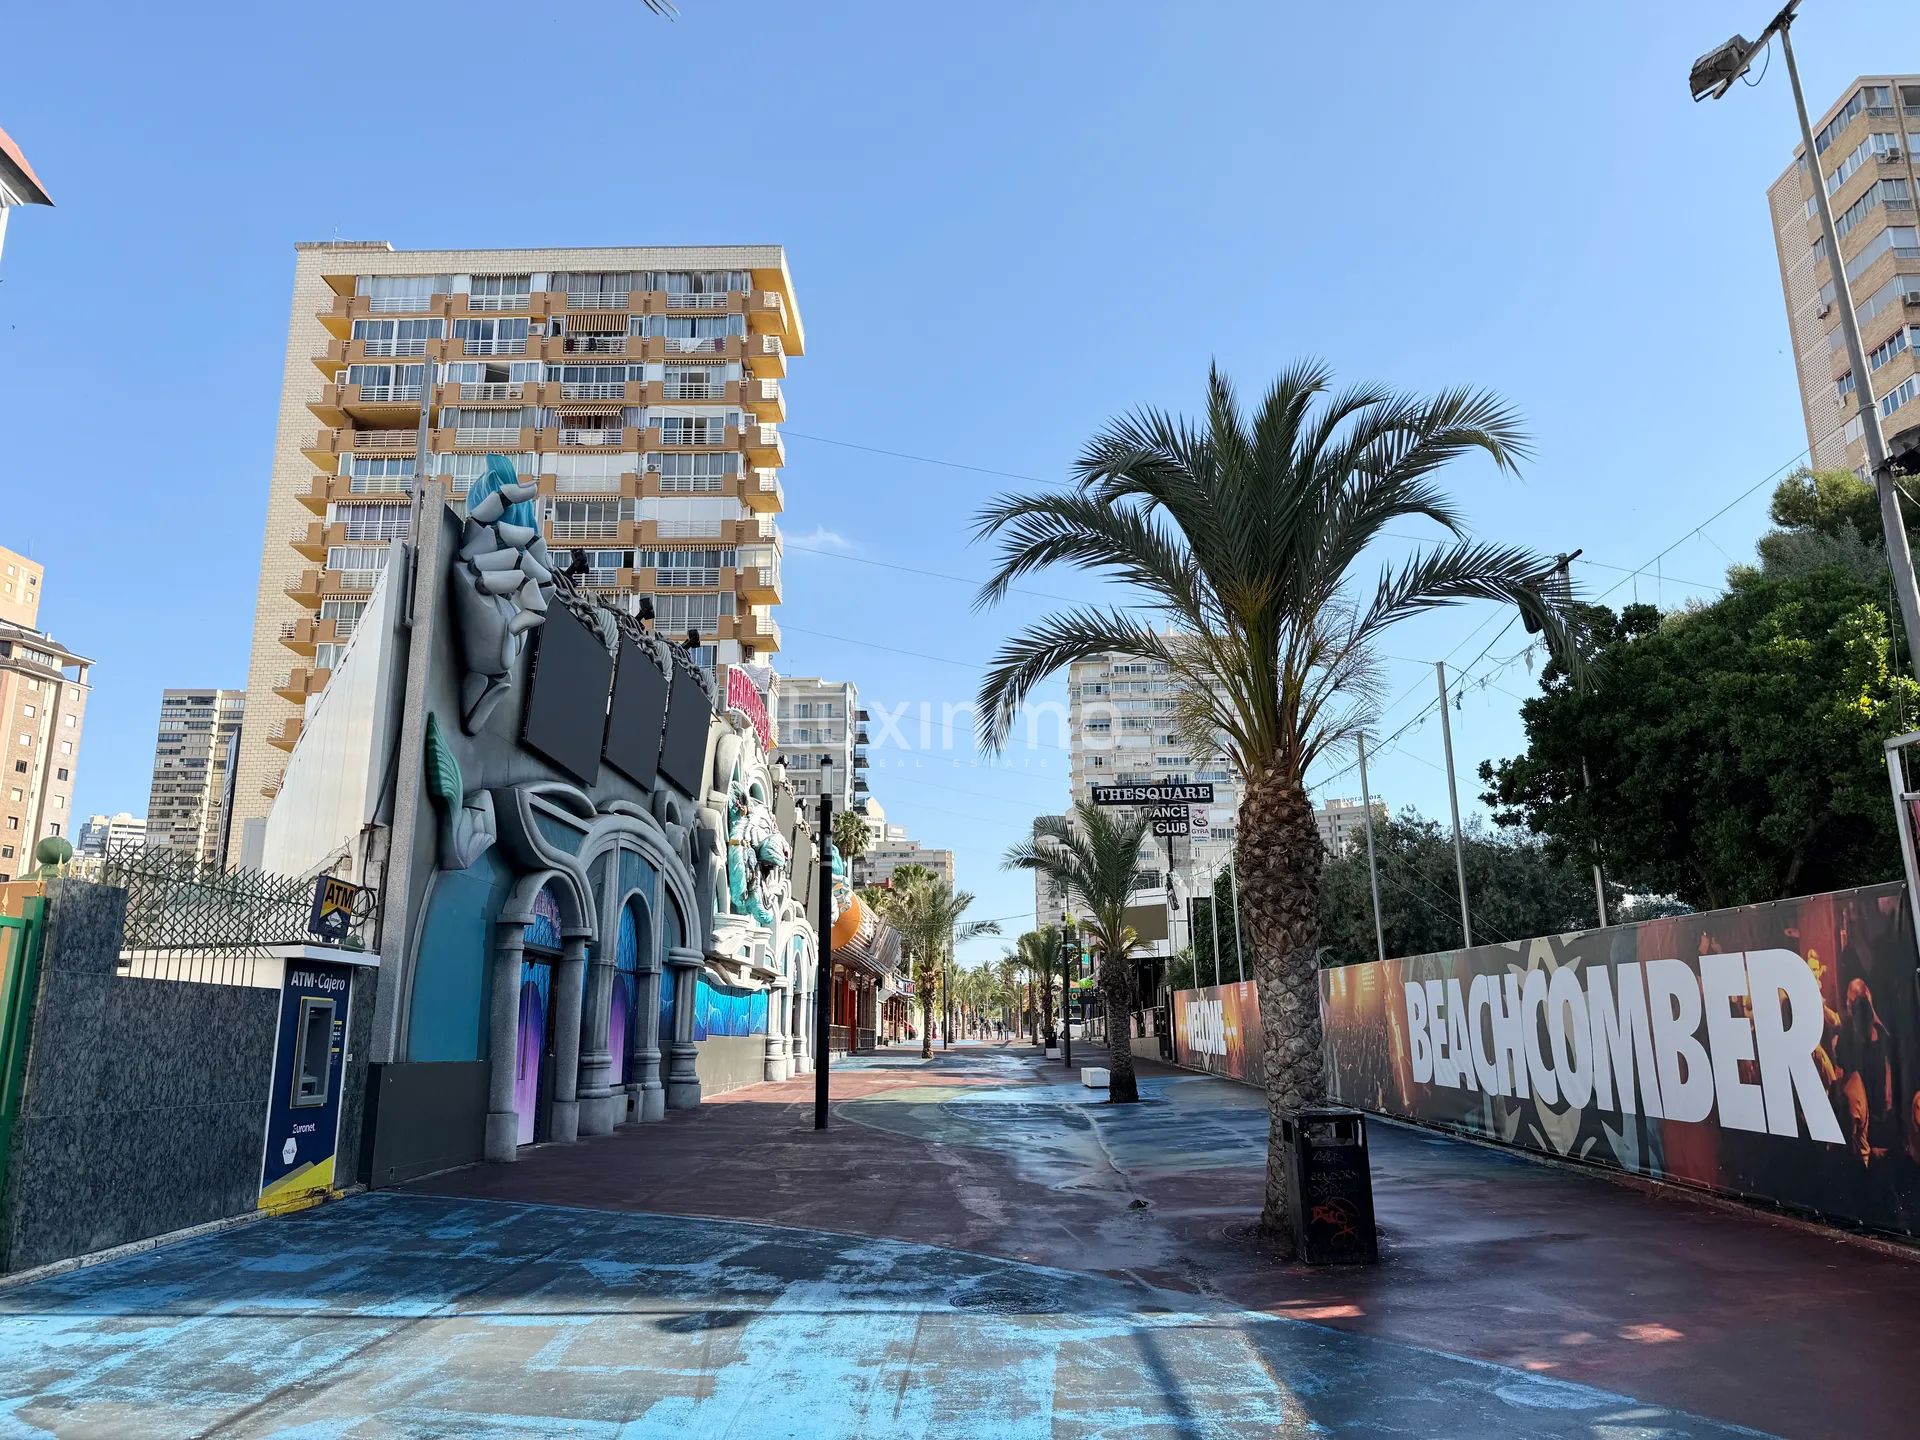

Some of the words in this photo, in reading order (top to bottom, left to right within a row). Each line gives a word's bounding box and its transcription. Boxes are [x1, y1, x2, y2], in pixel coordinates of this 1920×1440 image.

[1155, 822, 1187, 834] CLUB
[325, 883, 355, 909] ATM
[1185, 1000, 1227, 1056] WELCOME
[1405, 949, 1846, 1145] BEACHCOMBER
[292, 1123, 316, 1134] Euronet
